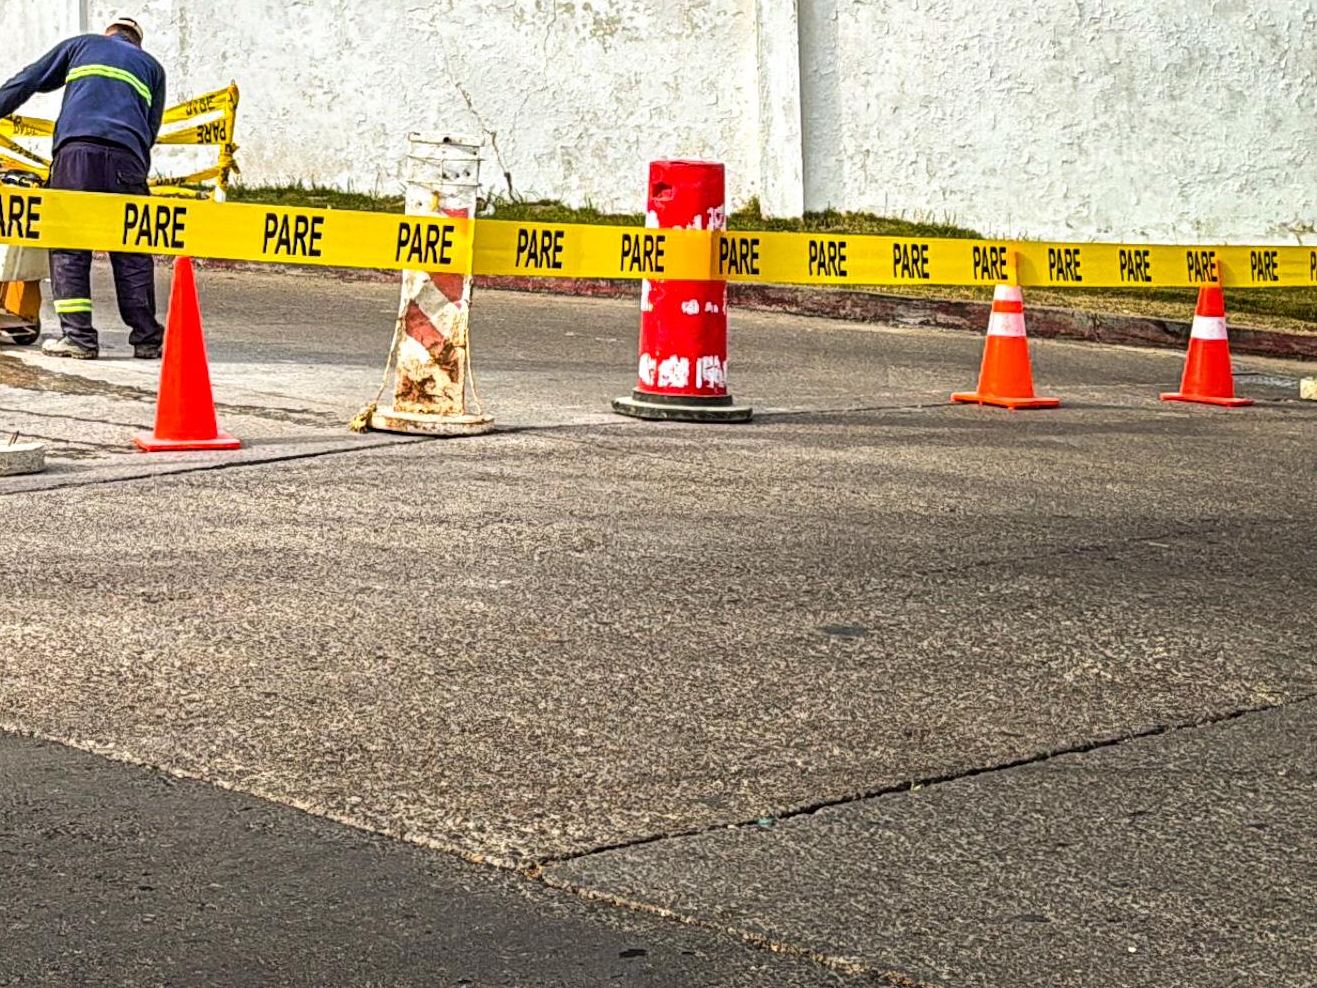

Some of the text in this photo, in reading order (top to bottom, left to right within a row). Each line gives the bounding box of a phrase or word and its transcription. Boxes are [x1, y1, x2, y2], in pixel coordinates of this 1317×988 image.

[123, 203, 186, 248] PARE
[263, 213, 324, 256] PARE
[396, 223, 454, 264] PARE
[516, 229, 564, 268] PARE
[621, 234, 665, 272] PARE
[719, 237, 759, 274] PARE
[809, 241, 847, 276] PARE
[894, 244, 929, 278] PARE
[973, 247, 1008, 279] PARE
[1049, 249, 1082, 281] PARE
[1120, 250, 1151, 282] PARE
[1187, 252, 1217, 282] PARE
[1251, 251, 1278, 281] PARE
